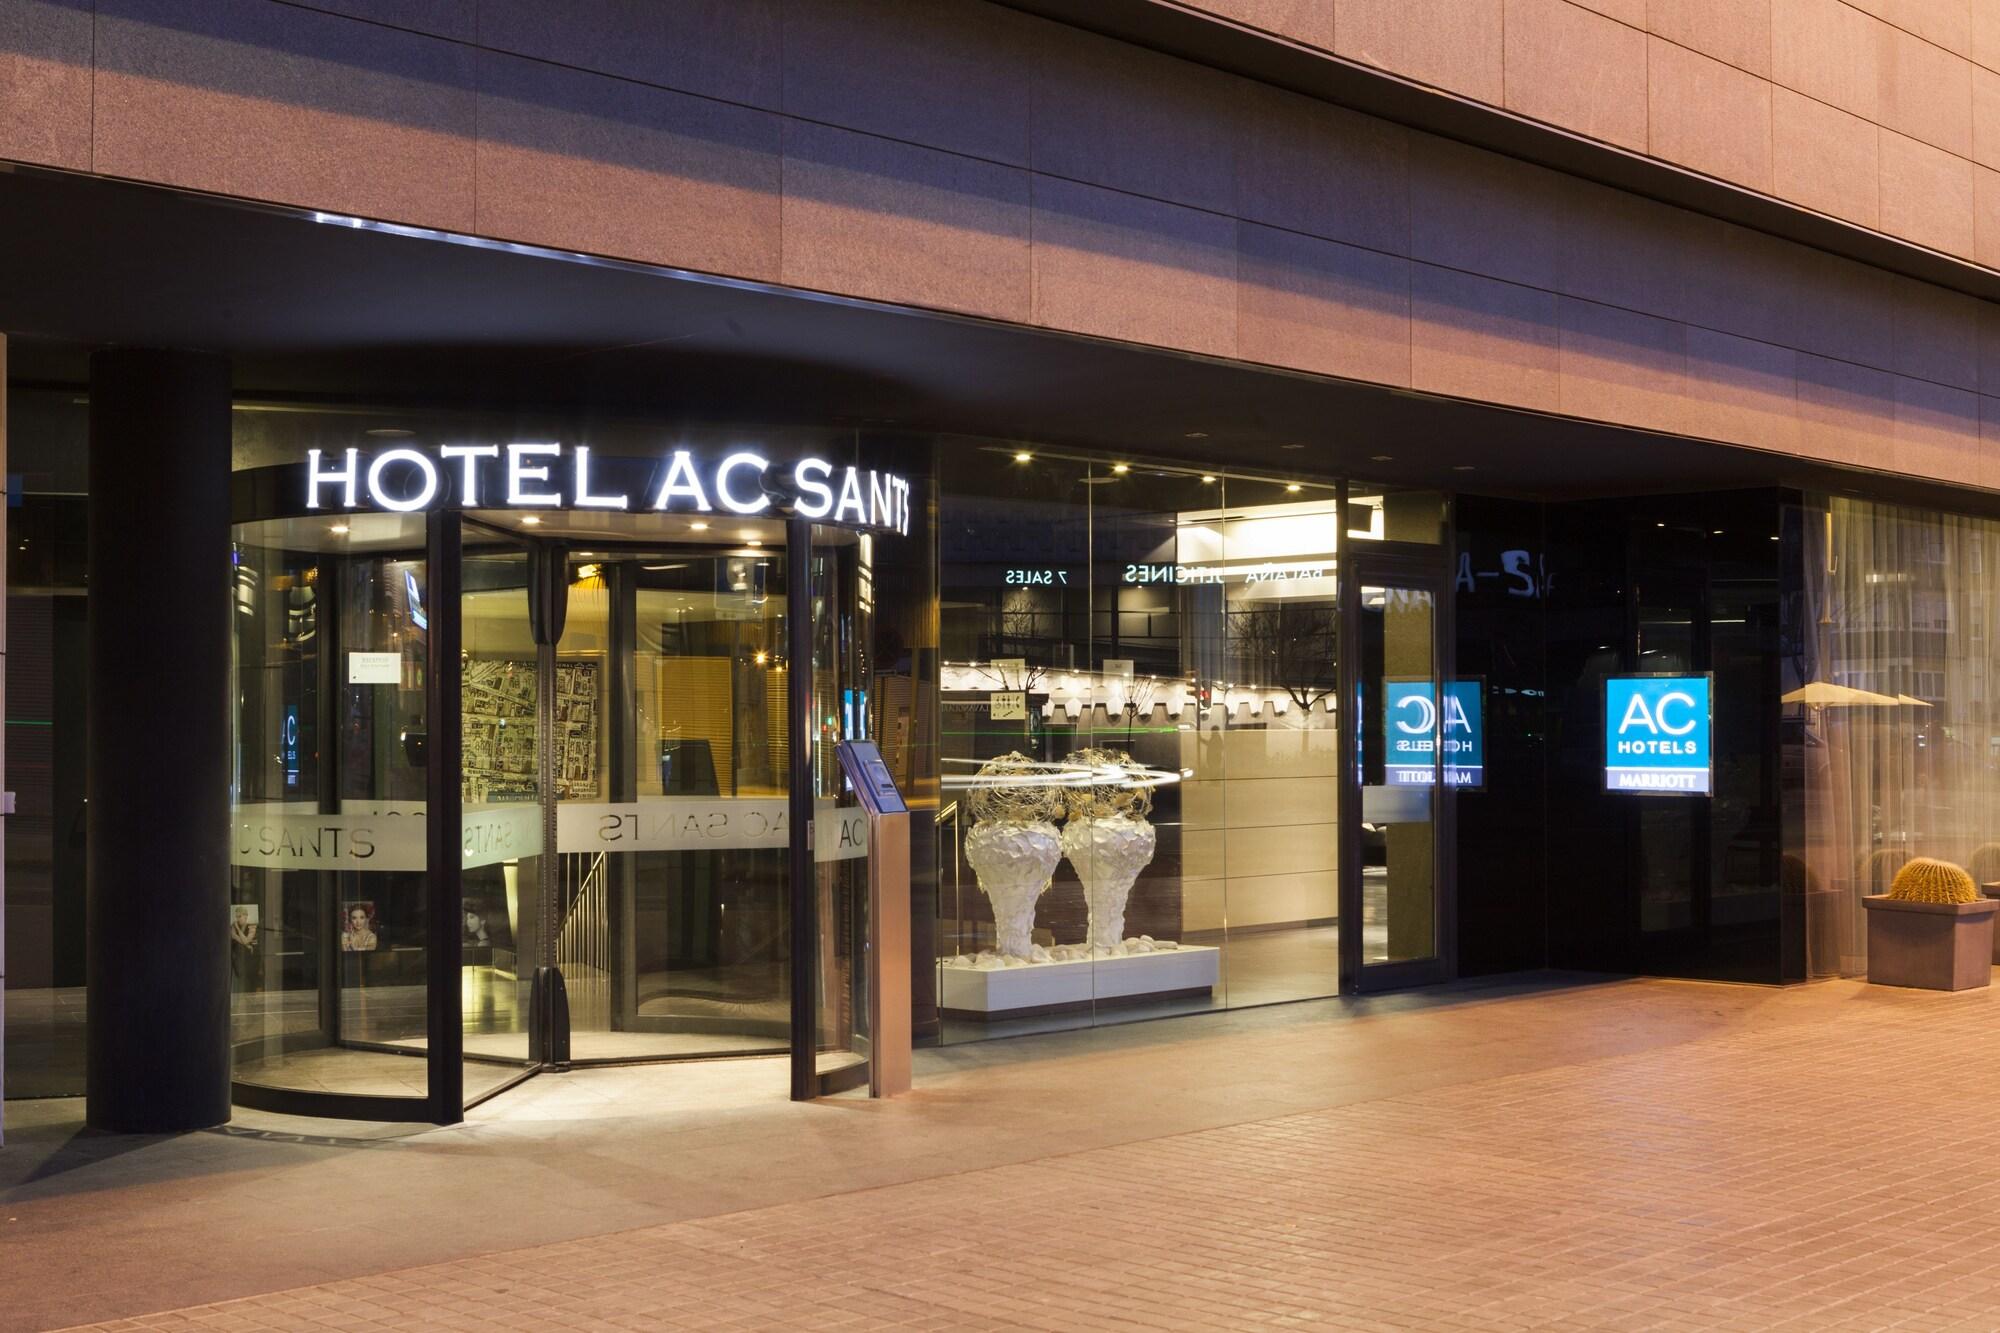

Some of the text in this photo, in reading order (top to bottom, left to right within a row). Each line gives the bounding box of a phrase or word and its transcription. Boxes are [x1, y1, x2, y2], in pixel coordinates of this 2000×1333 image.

[306, 442, 909, 537] HOTEL AC SANTS
[1618, 691, 1697, 736] AC
[1618, 740, 1697, 755] HOTELS
[1618, 773, 1697, 788] MARRIOTT
[258, 826, 375, 858] SANTS
[839, 819, 864, 848] AC
